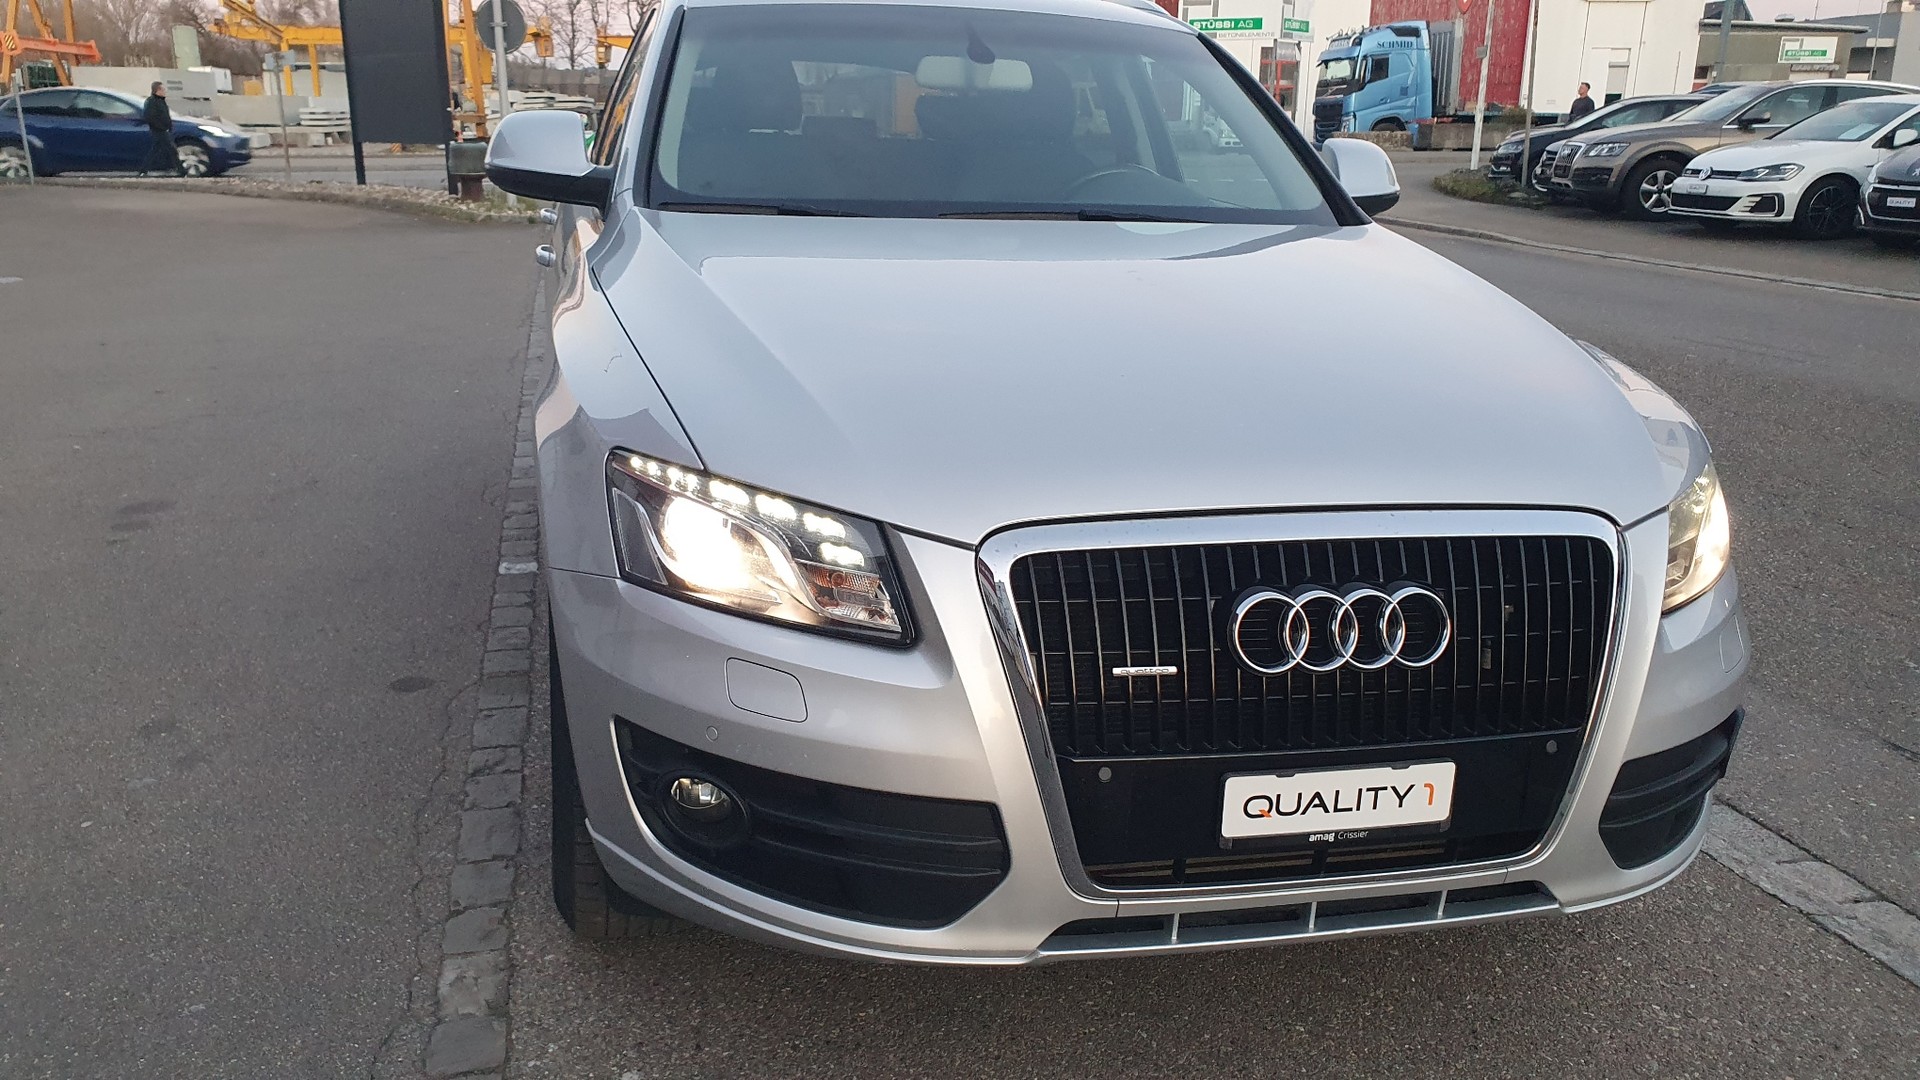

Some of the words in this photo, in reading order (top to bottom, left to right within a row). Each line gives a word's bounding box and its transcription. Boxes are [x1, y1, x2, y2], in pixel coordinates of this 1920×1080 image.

[1193, 19, 1235, 29] STÜSSI
[1237, 20, 1254, 28] AG
[1377, 40, 1413, 49] SCHMID
[1120, 668, 1169, 676] quattro
[1243, 784, 1416, 819] QUALITY
[1424, 783, 1435, 806] 1
[1309, 832, 1335, 842] amag
[1338, 830, 1369, 840] Crissier
